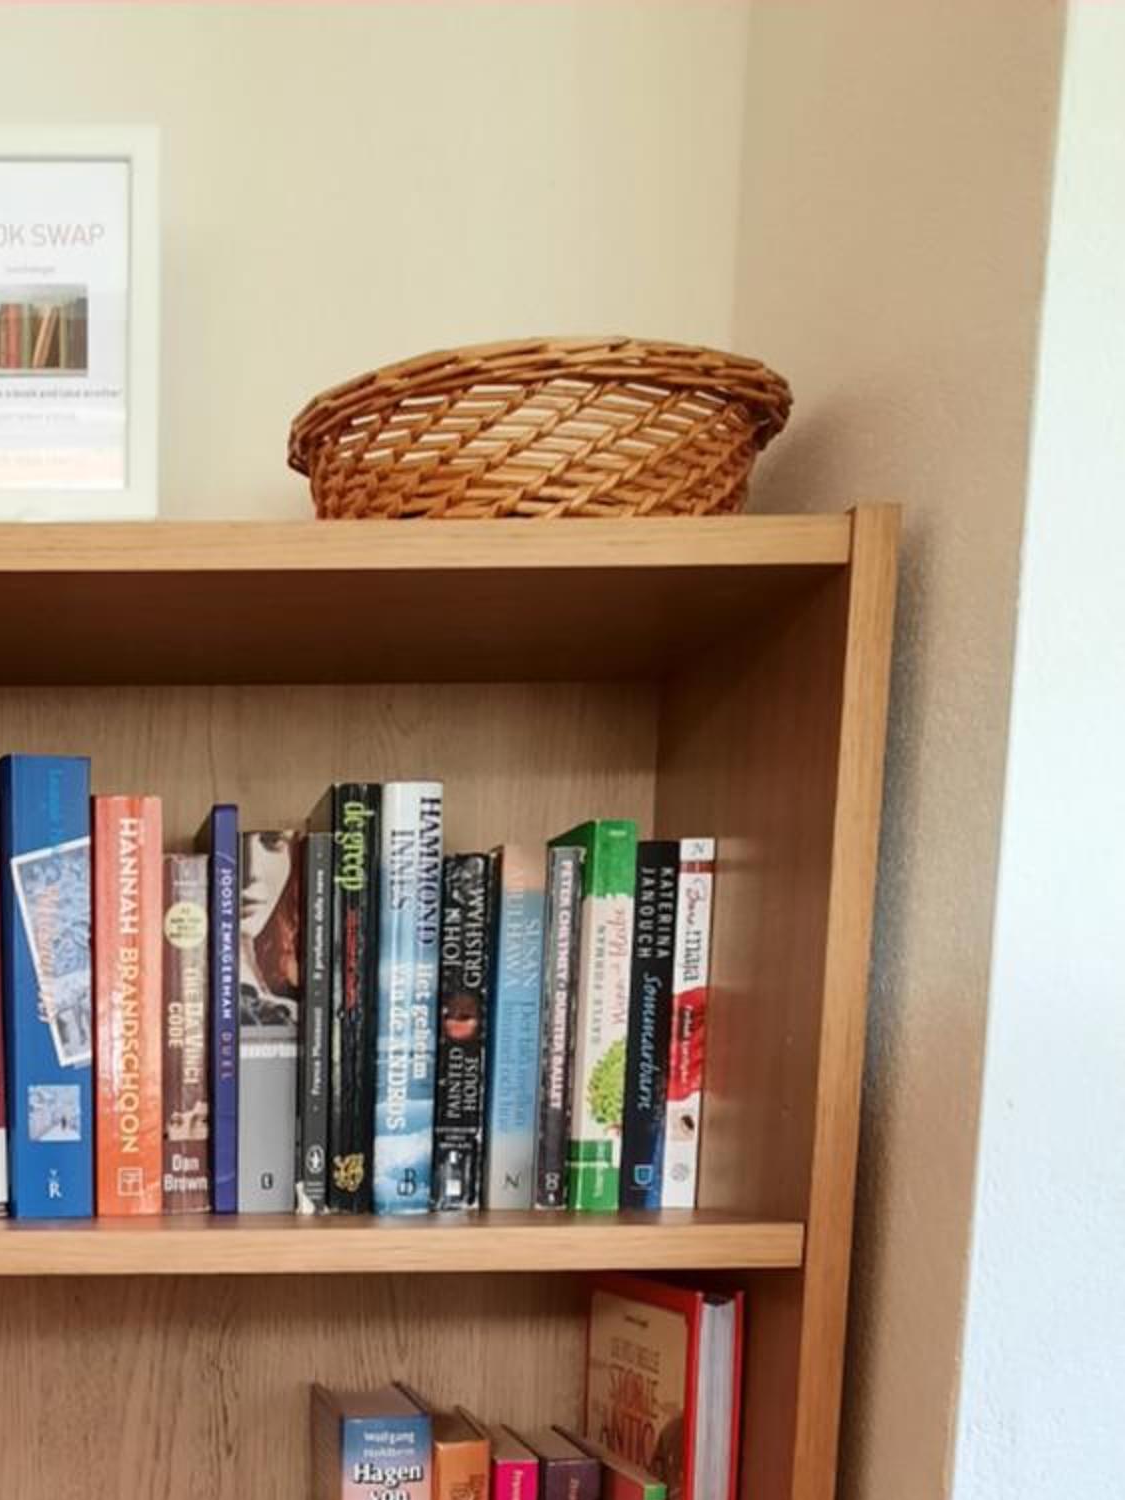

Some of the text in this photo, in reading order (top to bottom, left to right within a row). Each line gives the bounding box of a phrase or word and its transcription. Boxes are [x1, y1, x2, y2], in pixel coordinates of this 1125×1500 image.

[30, 223, 106, 248] SWAP
[343, 802, 372, 829] de
[119, 818, 139, 934] HANNAH
[336, 831, 368, 890] greep
[391, 829, 414, 912] INNES
[419, 797, 441, 944] HAMMOND
[221, 868, 232, 1019] JOOST ZWAGERMAN
[442, 908, 461, 966] JOHN
[464, 887, 485, 988] GRISHAM
[637, 866, 654, 959] JANOUCH
[657, 867, 673, 959] KATERINA
[523, 921, 540, 987] SUSAN
[119, 947, 139, 1153] BRANDSCHOON
[168, 1002, 184, 1048] CODE
[221, 1032, 232, 1080] DUEL
[636, 972, 662, 1110] Sommarbarn
[183, 1034, 201, 1084] VINCI
[387, 1039, 408, 1129] ANDROS
[446, 1047, 464, 1118] PAINTED
[464, 1057, 478, 1111] HOUSE
[163, 1175, 207, 1190] Brown
[172, 1155, 193, 1171] Dan
[354, 1463, 422, 1488] Hagen
